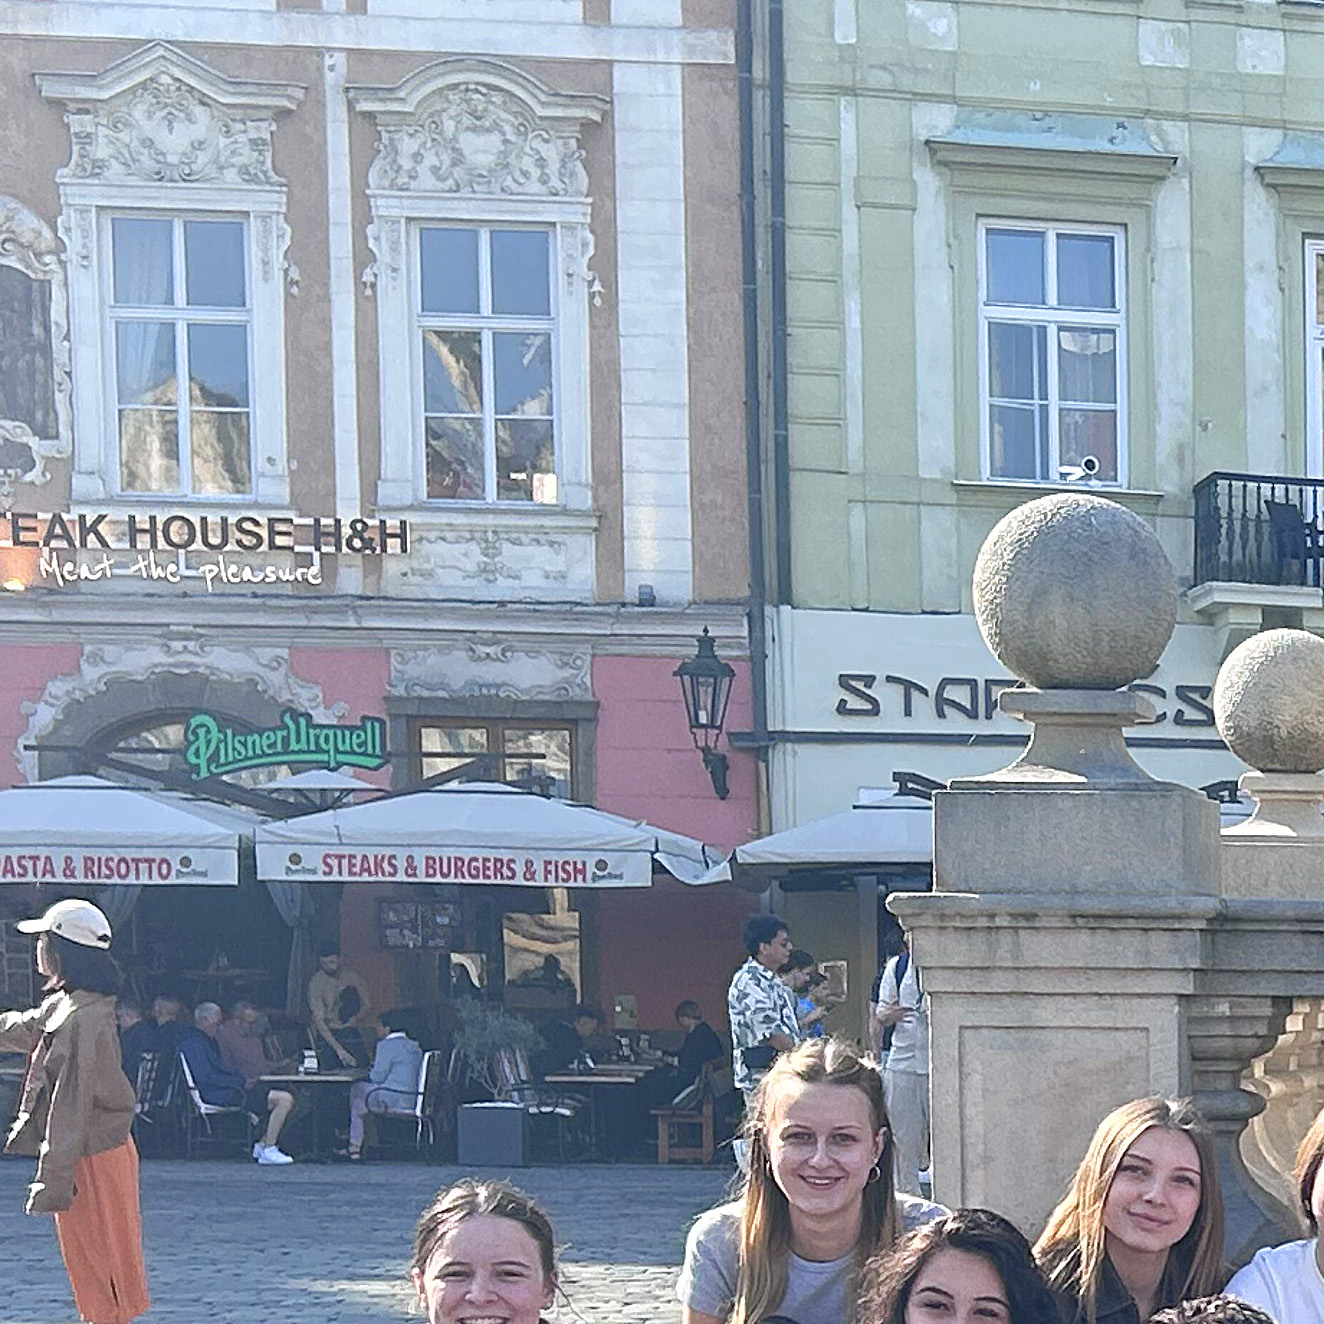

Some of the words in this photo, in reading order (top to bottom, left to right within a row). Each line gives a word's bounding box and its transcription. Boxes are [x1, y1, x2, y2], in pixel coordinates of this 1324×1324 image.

[0, 512, 112, 549] EAK
[128, 514, 294, 551] HOUSE
[313, 517, 408, 554] H&H
[40, 551, 115, 588] Meat
[130, 549, 182, 583] the
[200, 554, 323, 593] pleasure
[186, 714, 288, 780] Pilsner
[283, 712, 382, 769] Urquell
[0, 855, 57, 879] ASTA
[62, 856, 77, 880] &
[83, 855, 172, 881] RISOTTO
[322, 853, 398, 878] STEAKS
[404, 854, 418, 879] &
[424, 855, 517, 881] BURGERS
[522, 857, 537, 883] &
[543, 860, 587, 884] FISH
